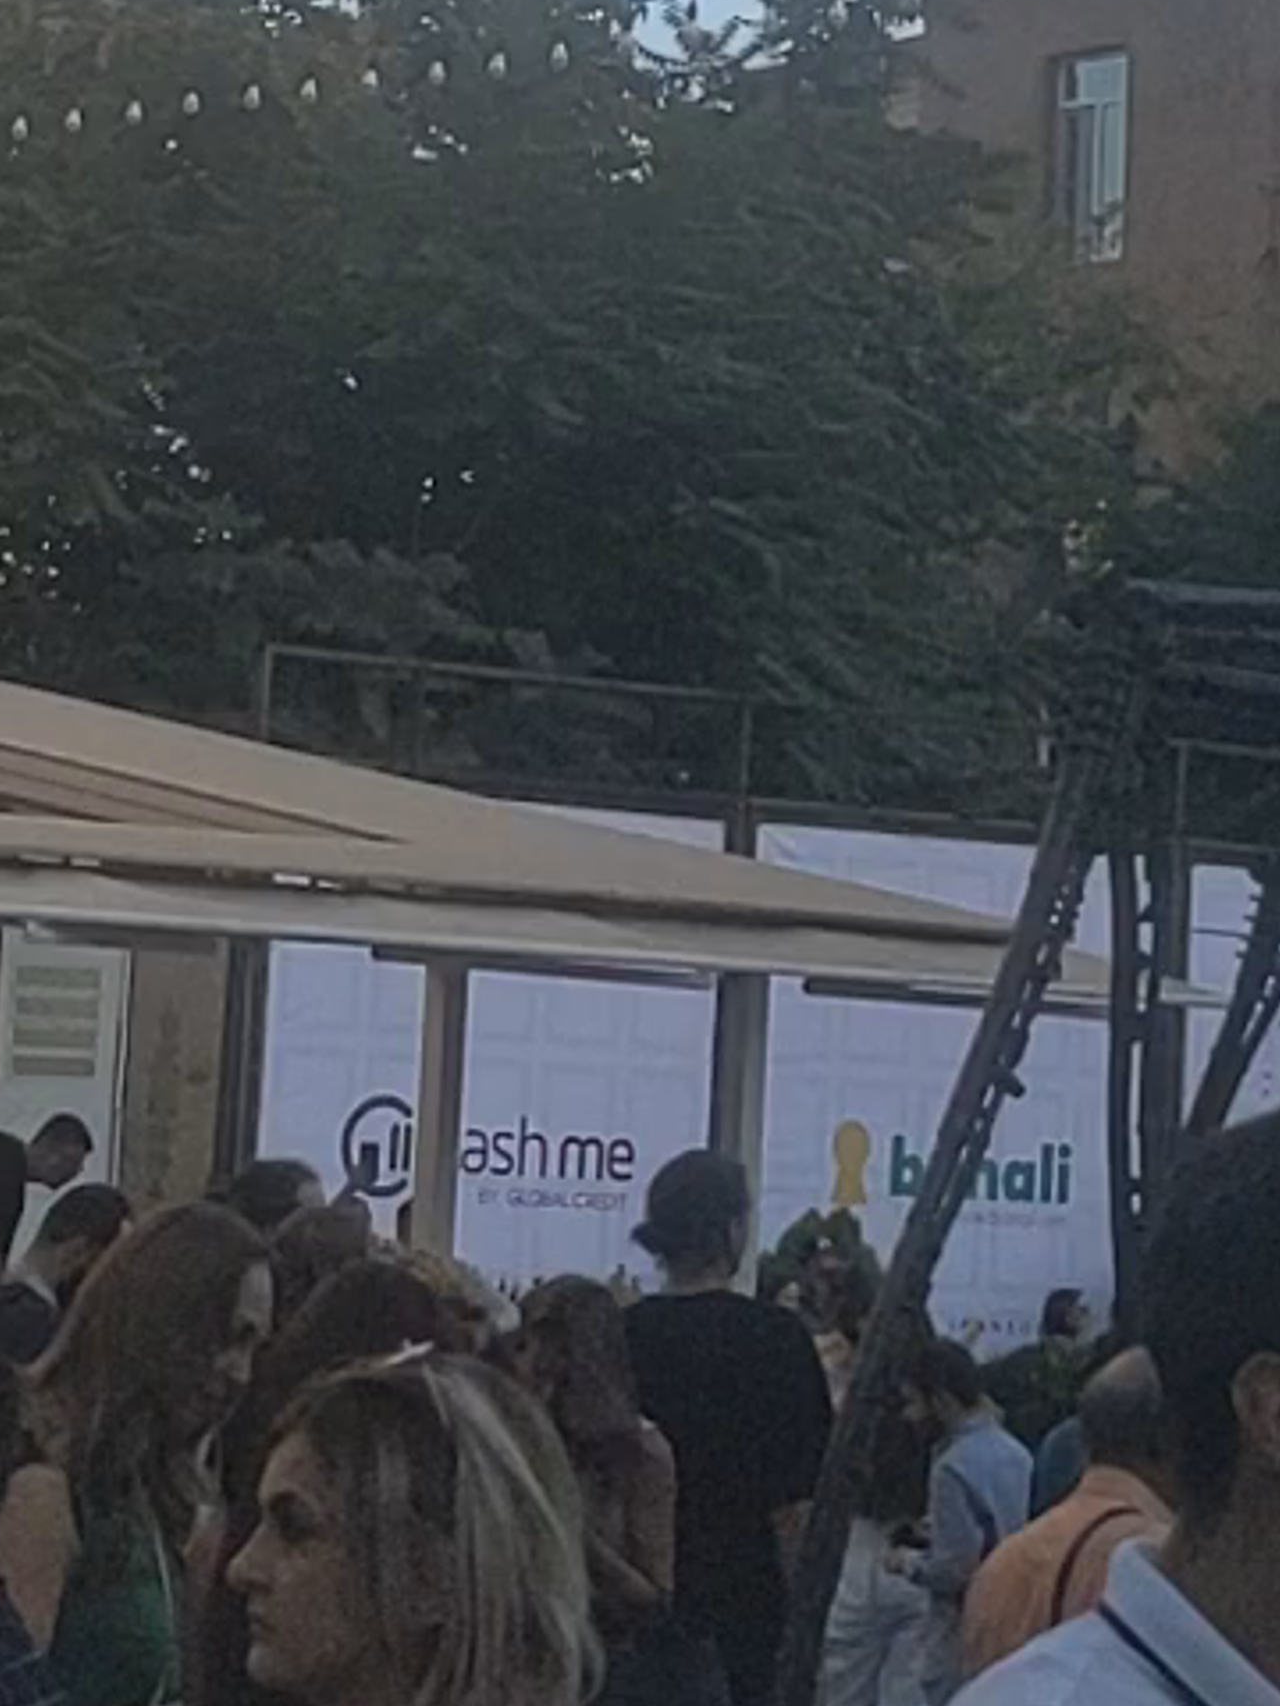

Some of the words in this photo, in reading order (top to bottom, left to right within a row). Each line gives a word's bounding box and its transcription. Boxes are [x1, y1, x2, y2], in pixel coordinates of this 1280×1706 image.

[460, 1114, 549, 1178] ash
[558, 1135, 635, 1181] me
[889, 1134, 1072, 1204] bnali
[478, 1190, 498, 1205] BY
